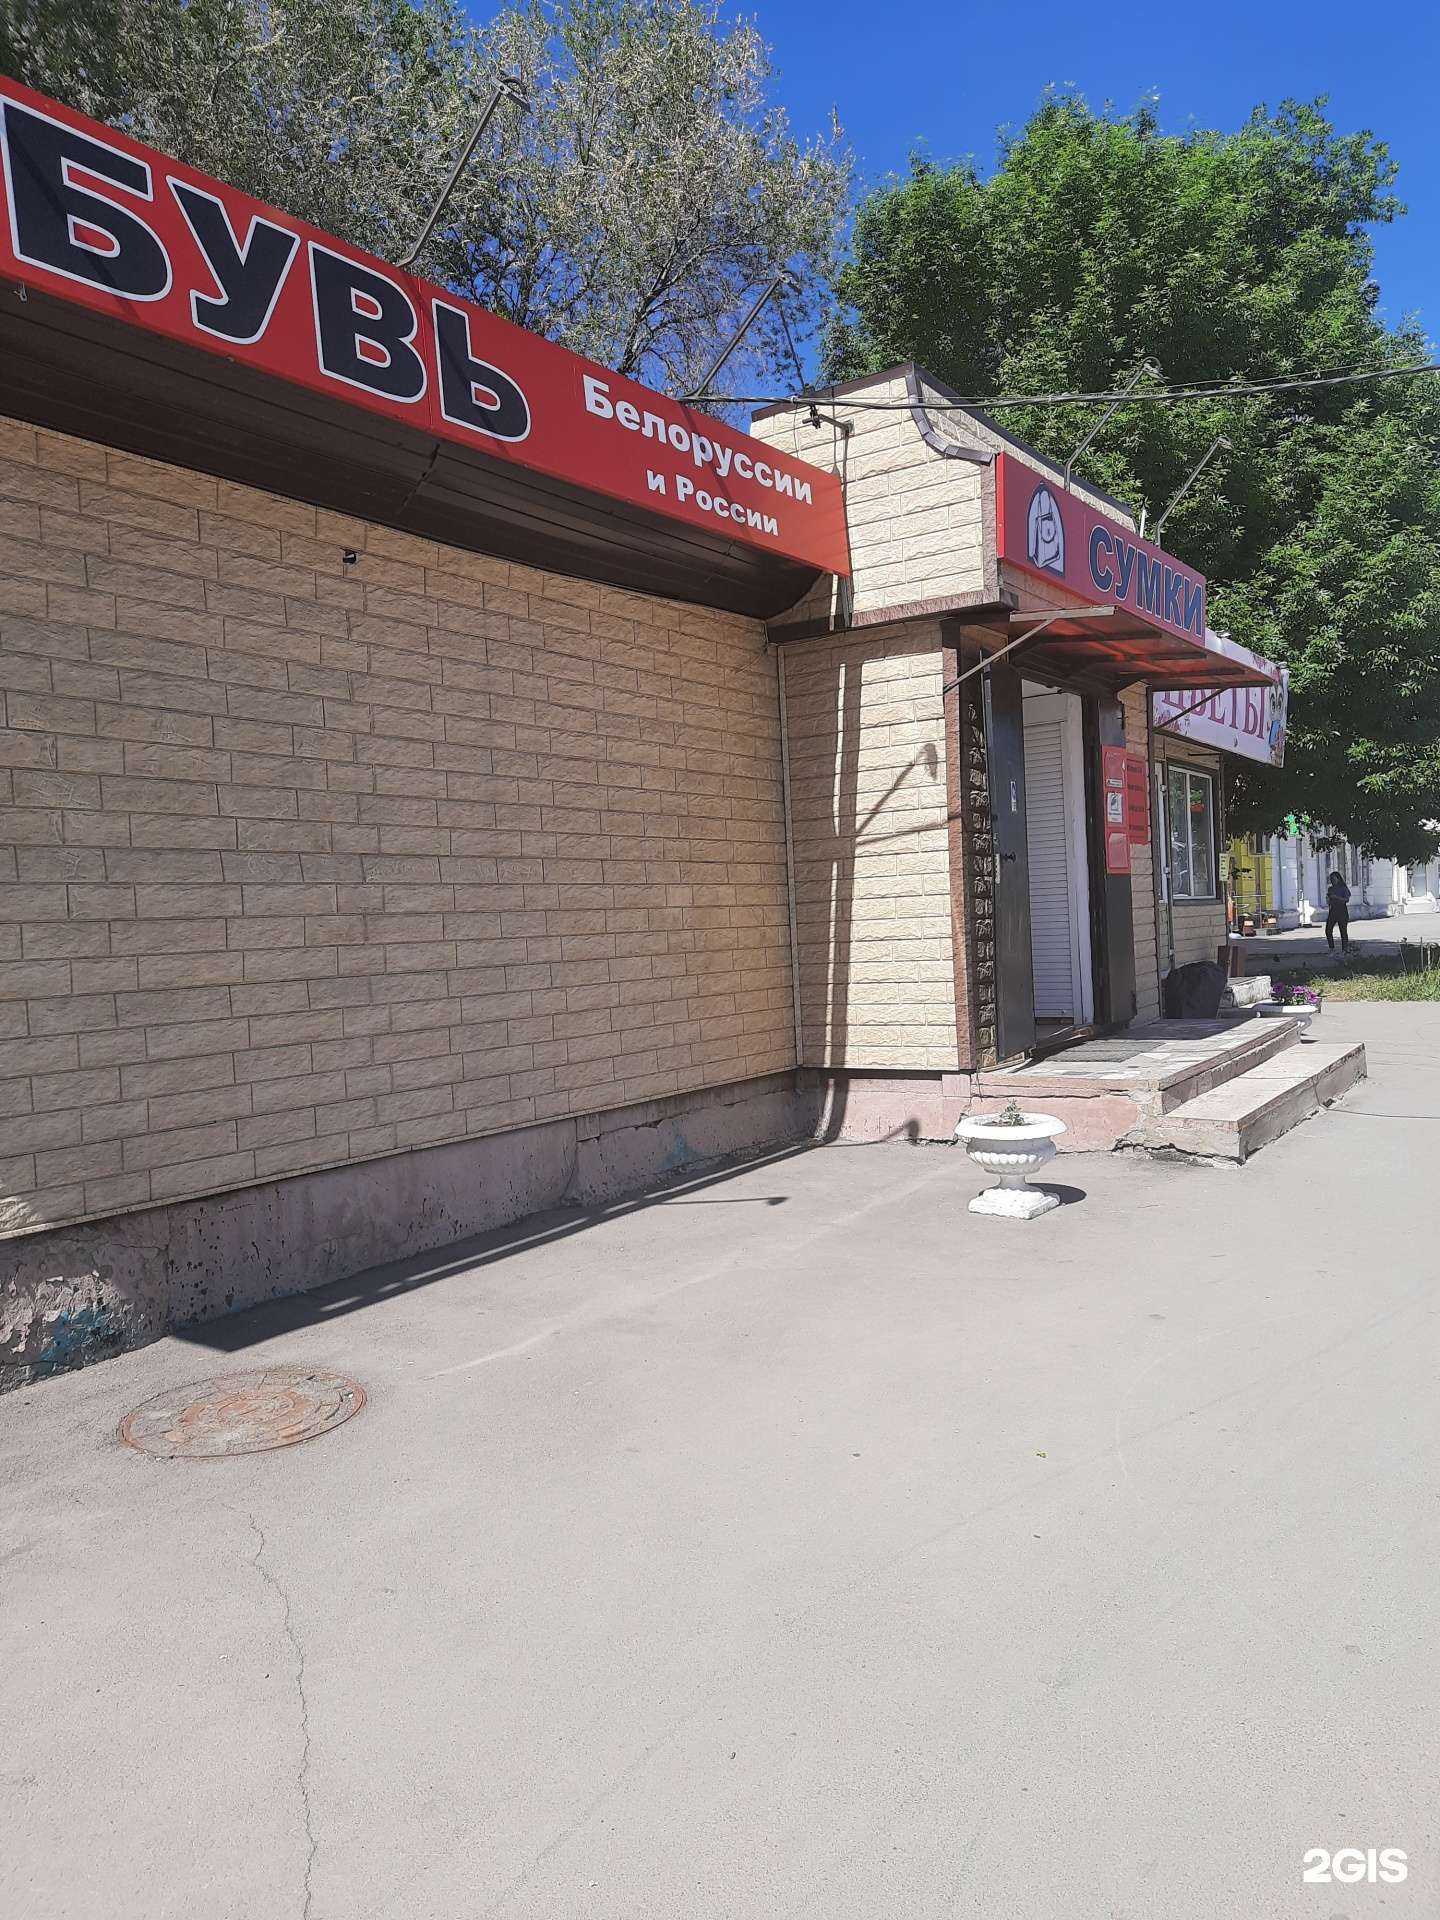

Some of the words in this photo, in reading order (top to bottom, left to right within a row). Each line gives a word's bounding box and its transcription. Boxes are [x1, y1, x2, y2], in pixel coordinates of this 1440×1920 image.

[0, 95, 531, 442] БУВЬ
[583, 374, 813, 505] Белоруссии
[646, 469, 666, 495] и
[675, 474, 779, 536] России
[1088, 525, 1203, 638] СУМКИ
[1162, 687, 1265, 740] ЕТЫ
